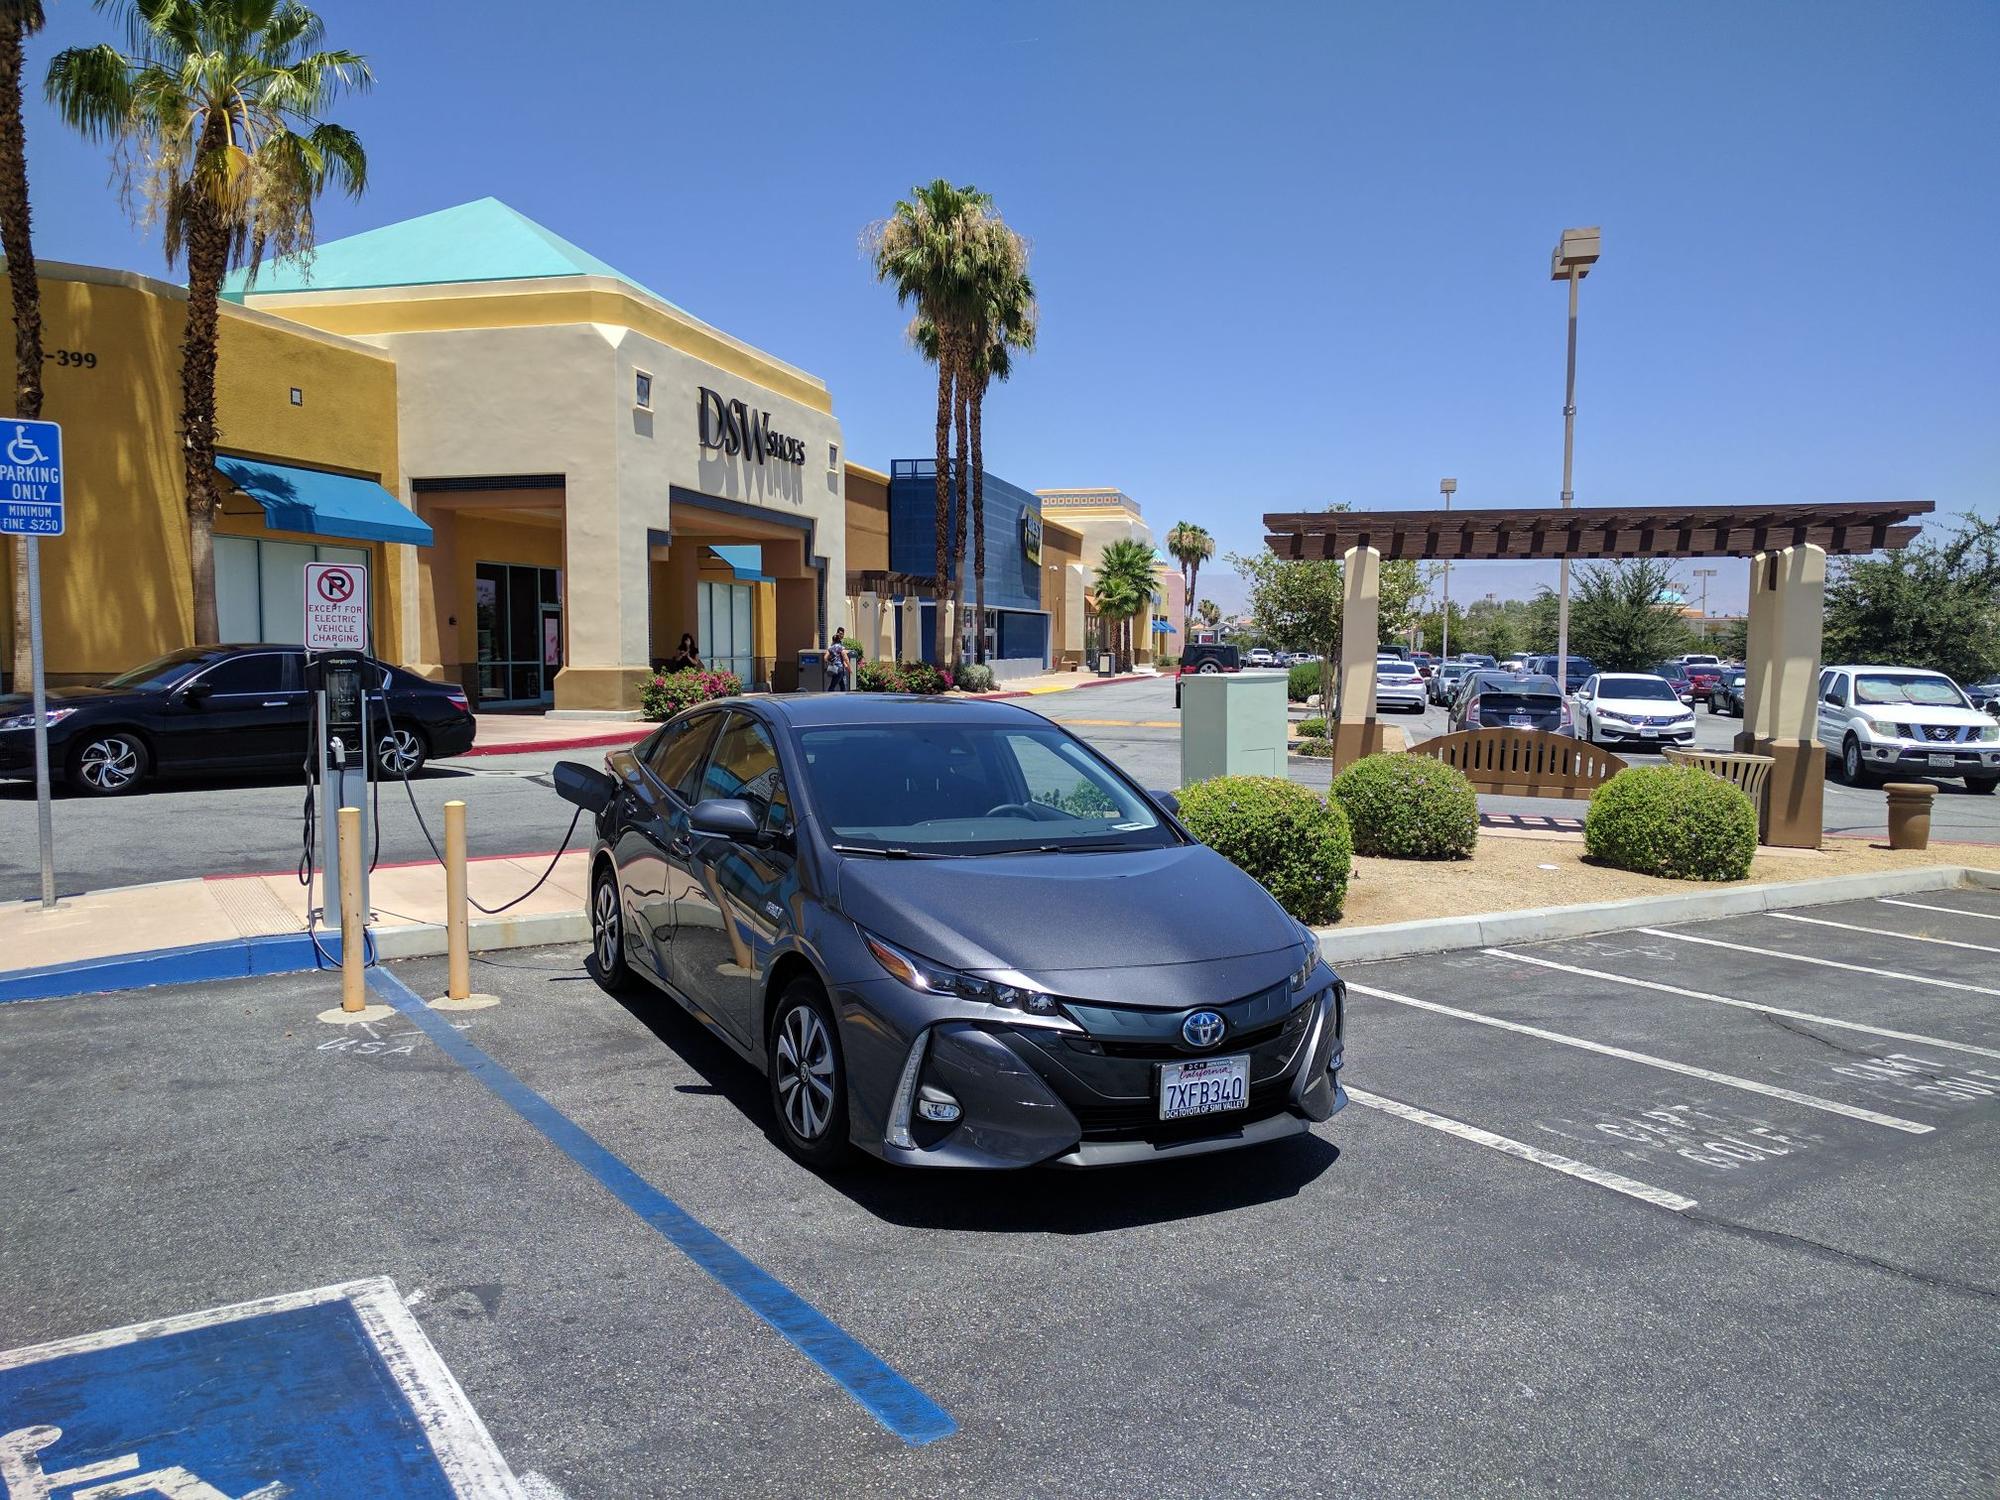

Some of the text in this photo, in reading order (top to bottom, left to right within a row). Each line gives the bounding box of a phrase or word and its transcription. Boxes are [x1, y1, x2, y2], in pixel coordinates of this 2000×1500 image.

[697, 386, 806, 466] DSW SHOES
[0, 465, 59, 484] PARKING
[12, 483, 48, 501] ONLY
[9, 505, 52, 518] MINIMUM
[3, 518, 59, 531] FINE $250
[309, 604, 362, 614] EXCEPT FOR
[314, 614, 357, 623] ELECTRIC
[316, 624, 355, 633] VEHICLE
[312, 634, 359, 643] CHARGING
[1180, 1067, 1233, 1080] California
[1167, 1077, 1242, 1110] 7XFB340
[1166, 1100, 1244, 1119] DCH TOYOTA OF SIMI VALLEY
